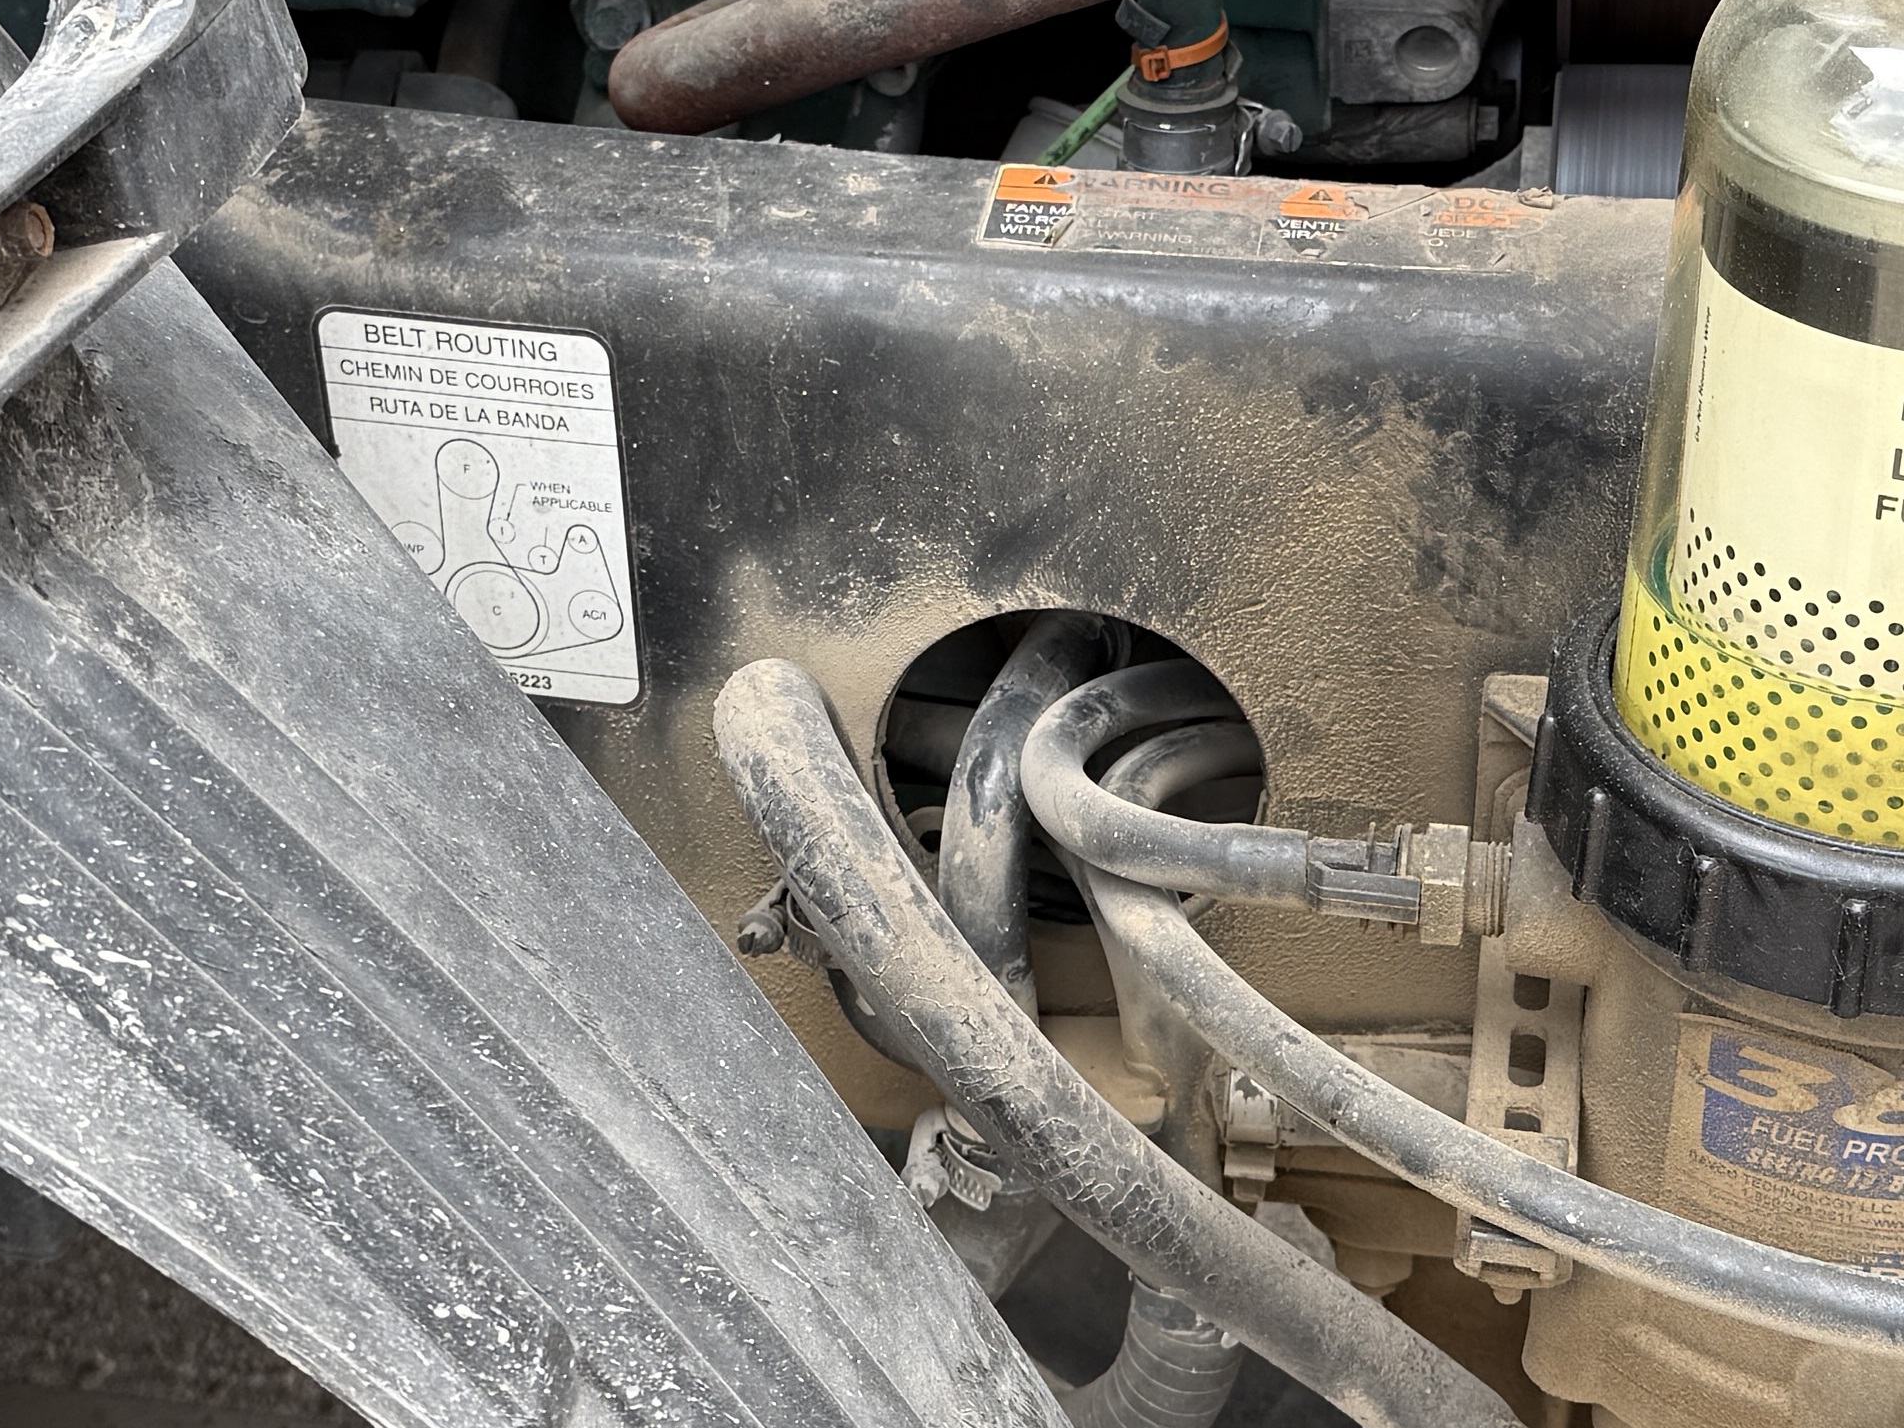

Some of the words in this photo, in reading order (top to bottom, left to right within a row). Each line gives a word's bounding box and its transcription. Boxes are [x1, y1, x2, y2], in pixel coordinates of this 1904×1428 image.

[1005, 203, 1045, 215] FAN
[1003, 213, 1030, 224] TO
[363, 323, 426, 351] BELT
[436, 330, 558, 362] ROUTING
[340, 358, 423, 385] CHEMIN
[429, 367, 459, 388] DE
[464, 371, 595, 401] COURROIES
[369, 396, 424, 419] RUTA
[429, 401, 459, 421] DE
[464, 405, 492, 424] LA
[497, 409, 570, 433] BANDA
[529, 480, 571, 495] WHEN
[531, 495, 614, 513] APPLICABLE
[578, 534, 587, 545] A
[539, 554, 547, 565] T
[492, 605, 502, 616] C
[1749, 1115, 1832, 1156] FUEL
[1747, 1146, 1837, 1184] SEEING
[1743, 1173, 1856, 1211] TECHNOLOGY
